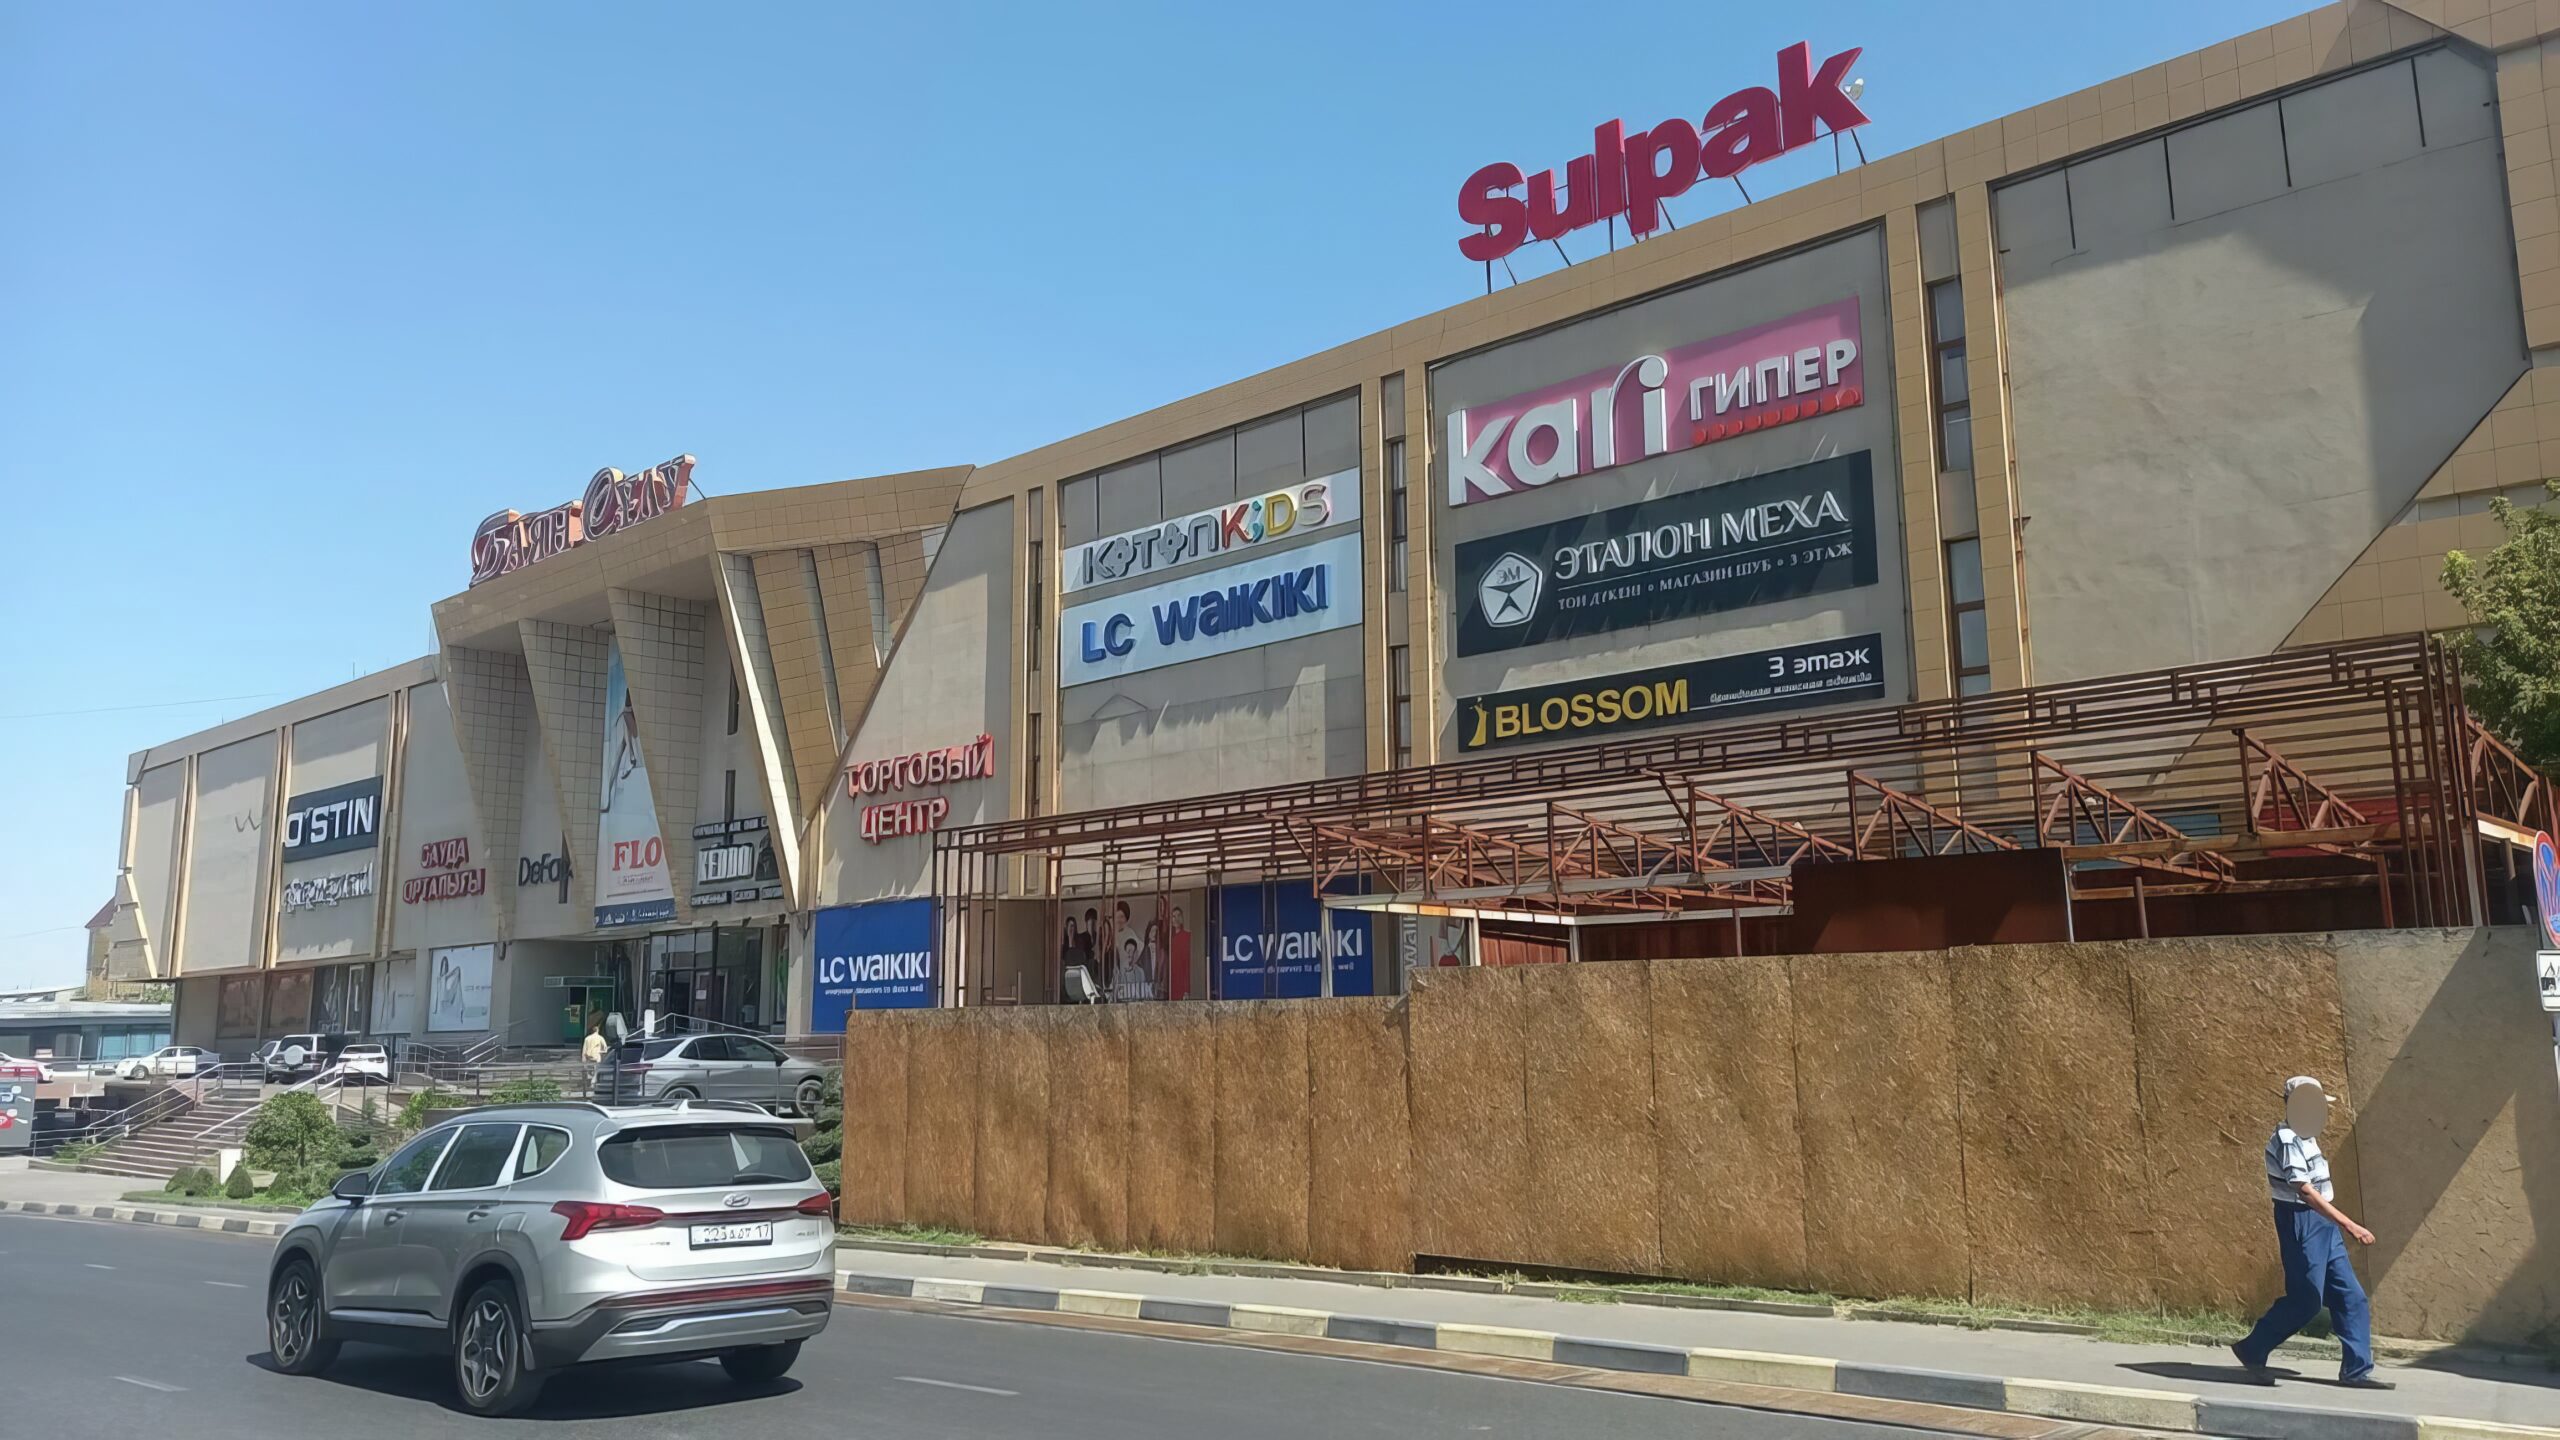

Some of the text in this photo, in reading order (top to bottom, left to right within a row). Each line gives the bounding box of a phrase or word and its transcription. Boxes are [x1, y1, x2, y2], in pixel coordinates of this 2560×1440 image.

[1458, 40, 1872, 262] Sulpak
[1689, 338, 1857, 421] ГИПЕР
[1447, 354, 1669, 508] kari
[1554, 490, 1849, 580] ЭТАЛОН МЕХА
[1802, 541, 1853, 565] ЭТАЖ
[1081, 613, 1136, 664] LC
[1768, 656, 1785, 678] 3
[1495, 679, 1689, 739] BLOSSOM
[845, 733, 995, 799] ТОРГОВЫЙ
[285, 795, 375, 848] O'STIN
[860, 797, 949, 845] ЦЕНТР
[612, 837, 662, 871] FLO
[819, 956, 846, 984] LC
[1222, 935, 1253, 962] LC
